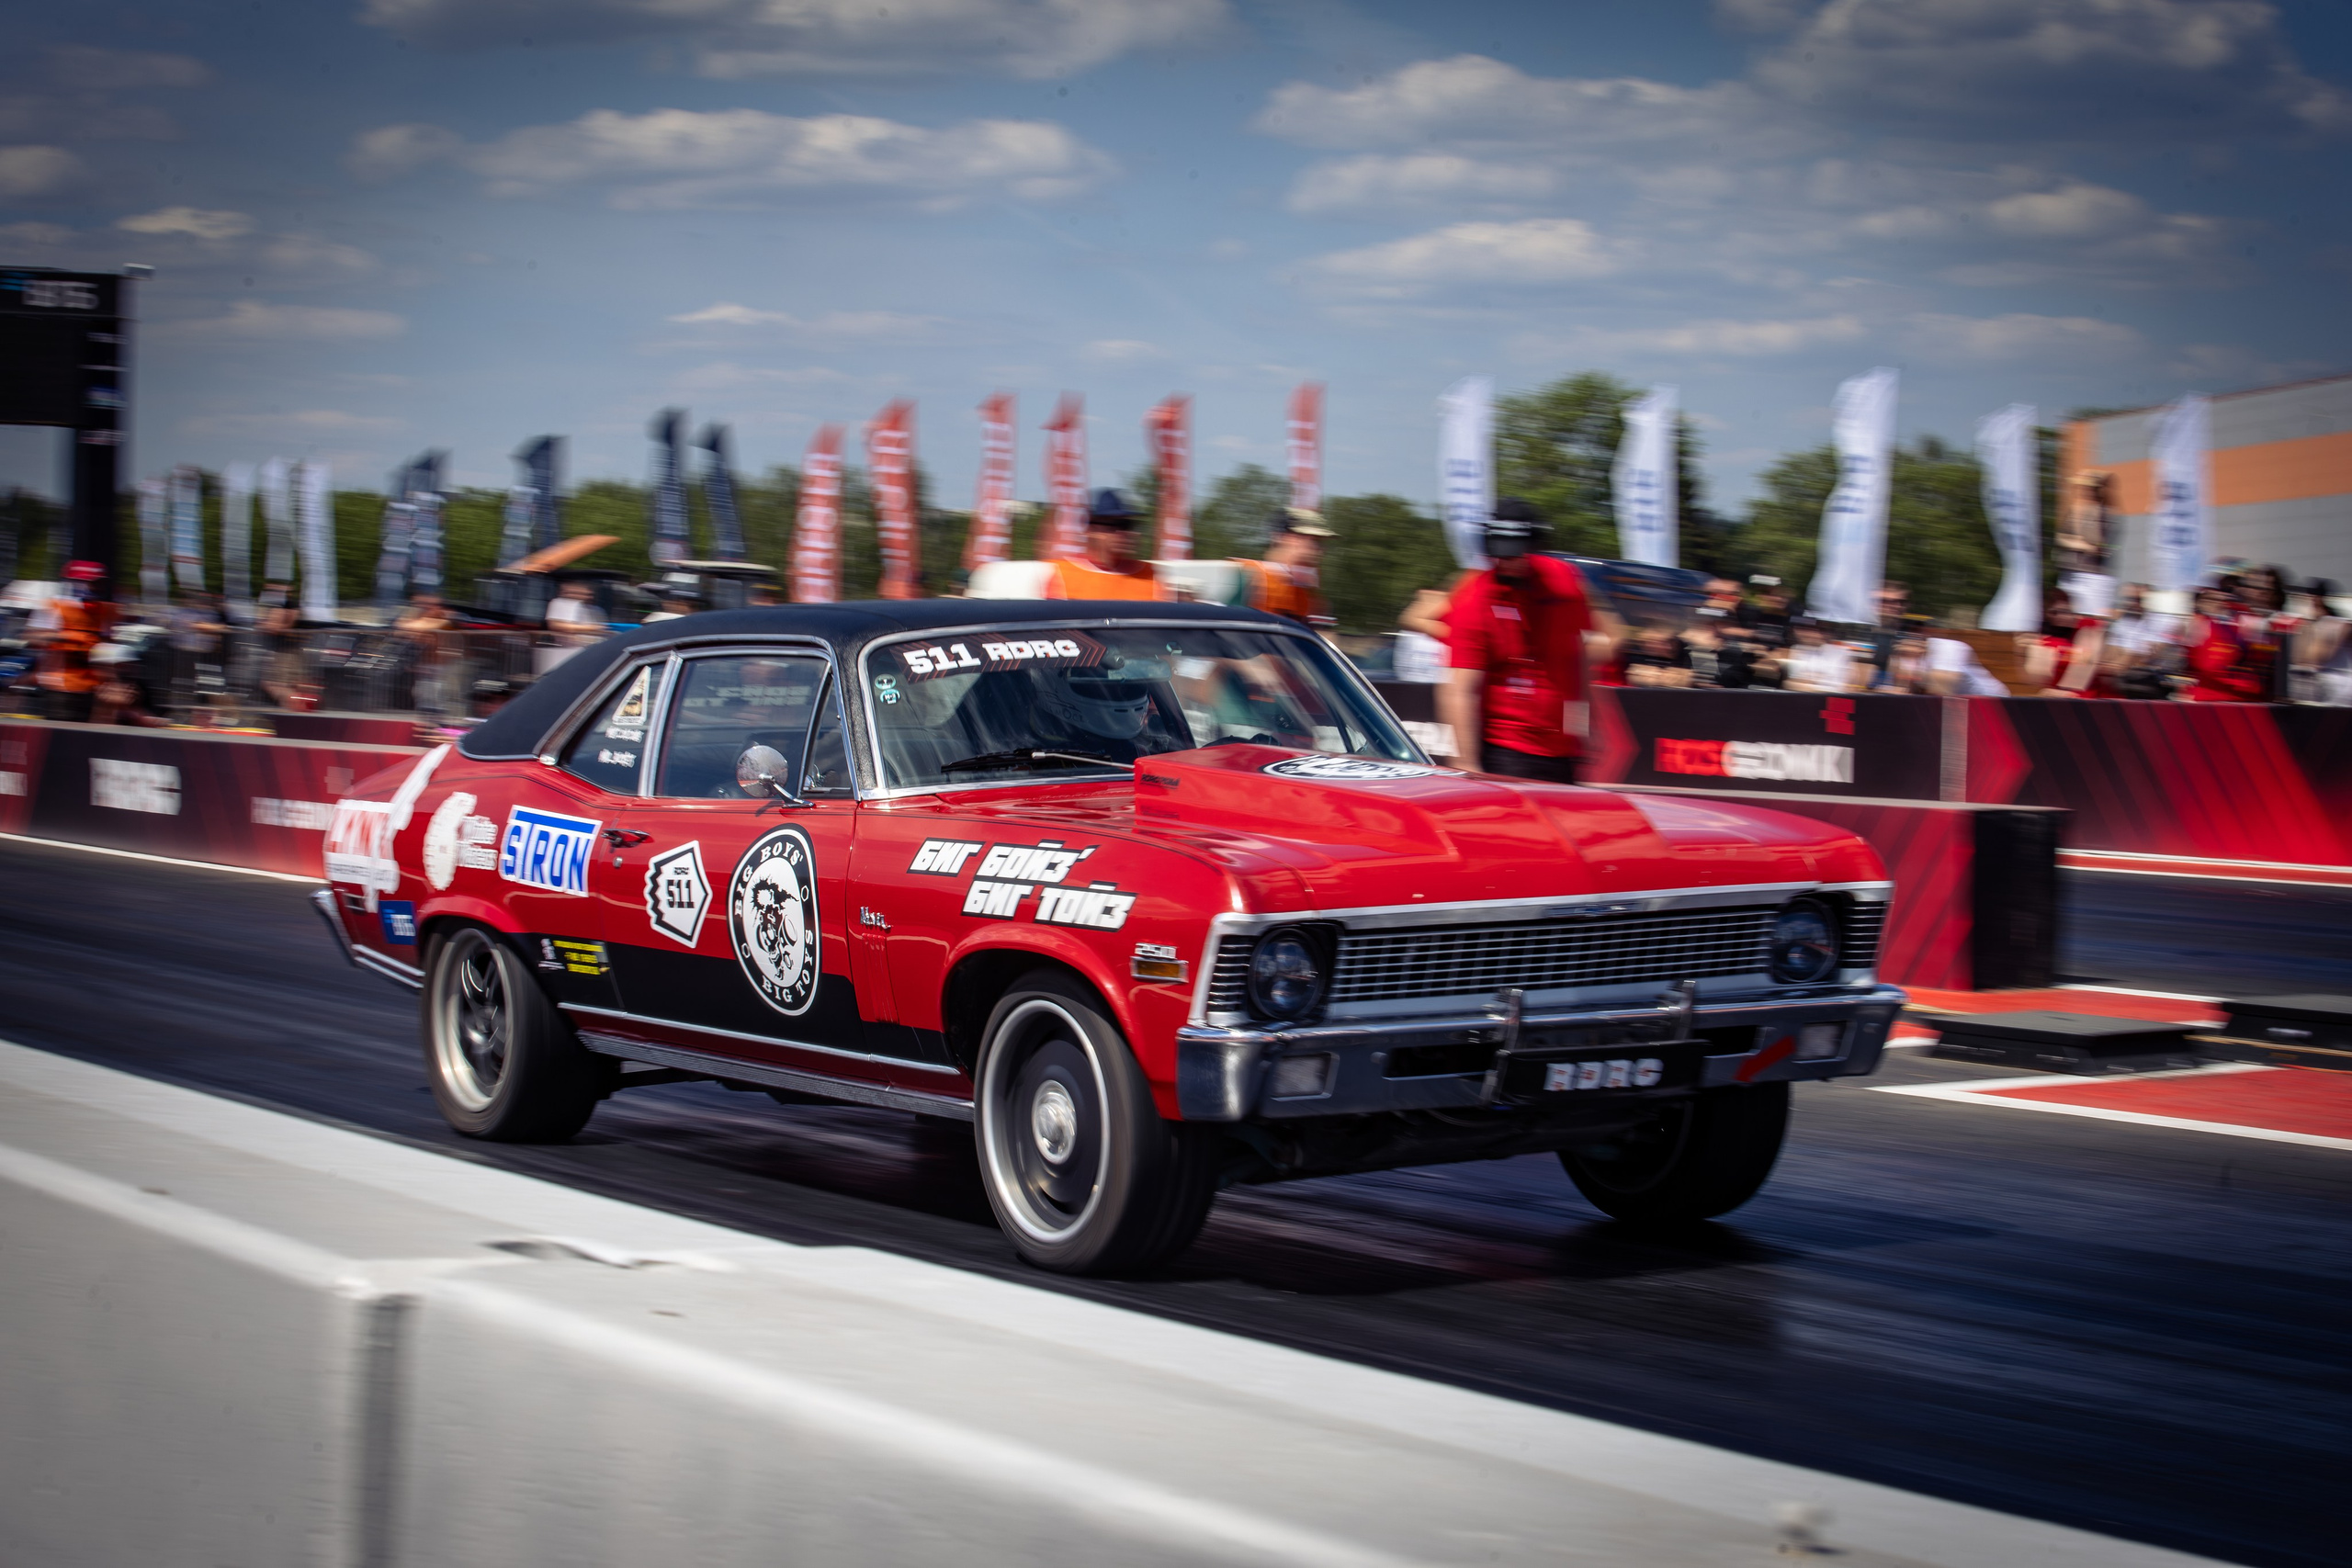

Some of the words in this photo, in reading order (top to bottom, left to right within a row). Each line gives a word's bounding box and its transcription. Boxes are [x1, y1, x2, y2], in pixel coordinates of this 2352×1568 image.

[903, 643, 981, 674] 511
[910, 840, 984, 874] БИГ
[666, 879, 695, 908] 511
[735, 864, 753, 918] BIG
[962, 880, 1035, 917] БИГ
[762, 975, 794, 1003] BIG
[796, 928, 814, 998] TOYS
